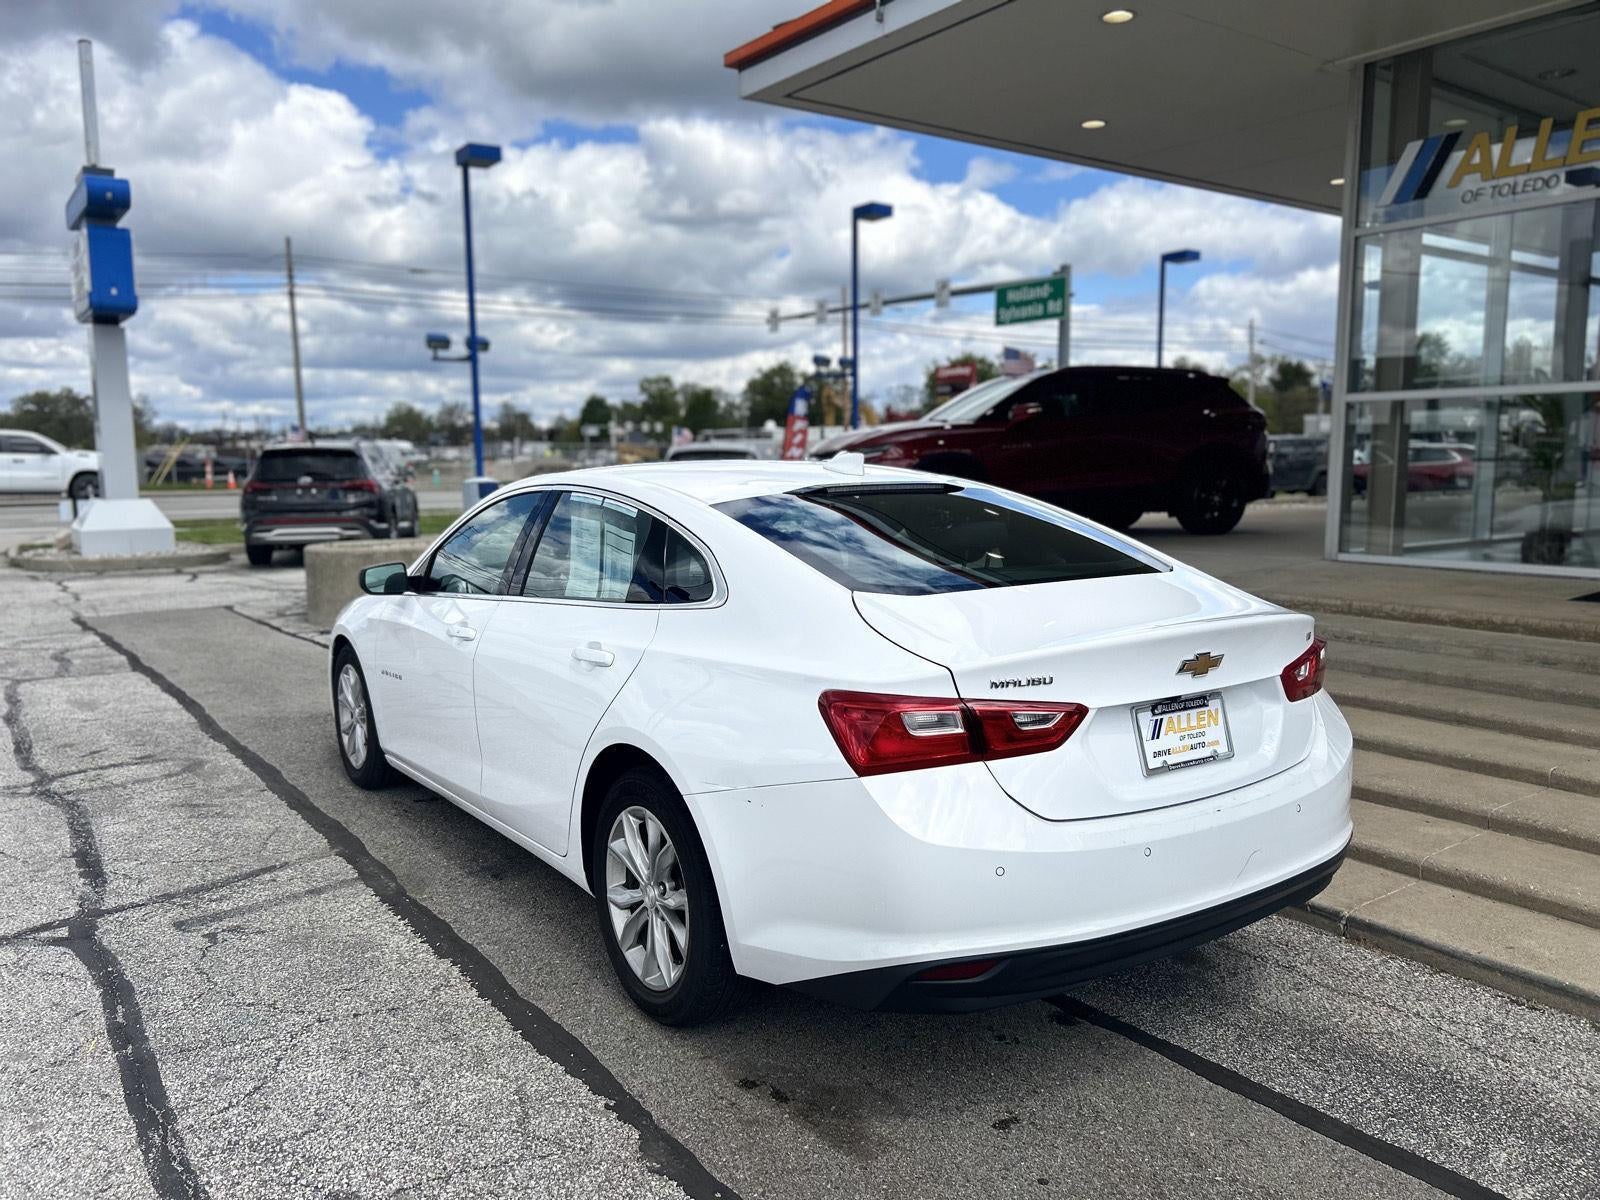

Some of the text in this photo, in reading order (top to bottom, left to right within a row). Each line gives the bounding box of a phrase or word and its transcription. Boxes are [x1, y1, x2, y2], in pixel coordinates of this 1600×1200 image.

[1461, 174, 1560, 204] OF TOLEDO
[990, 675, 1054, 689] MALIBU
[1162, 703, 1179, 711] ALLEN
[1164, 708, 1219, 736] ALLEN
[1187, 730, 1206, 740] TOLEDO
